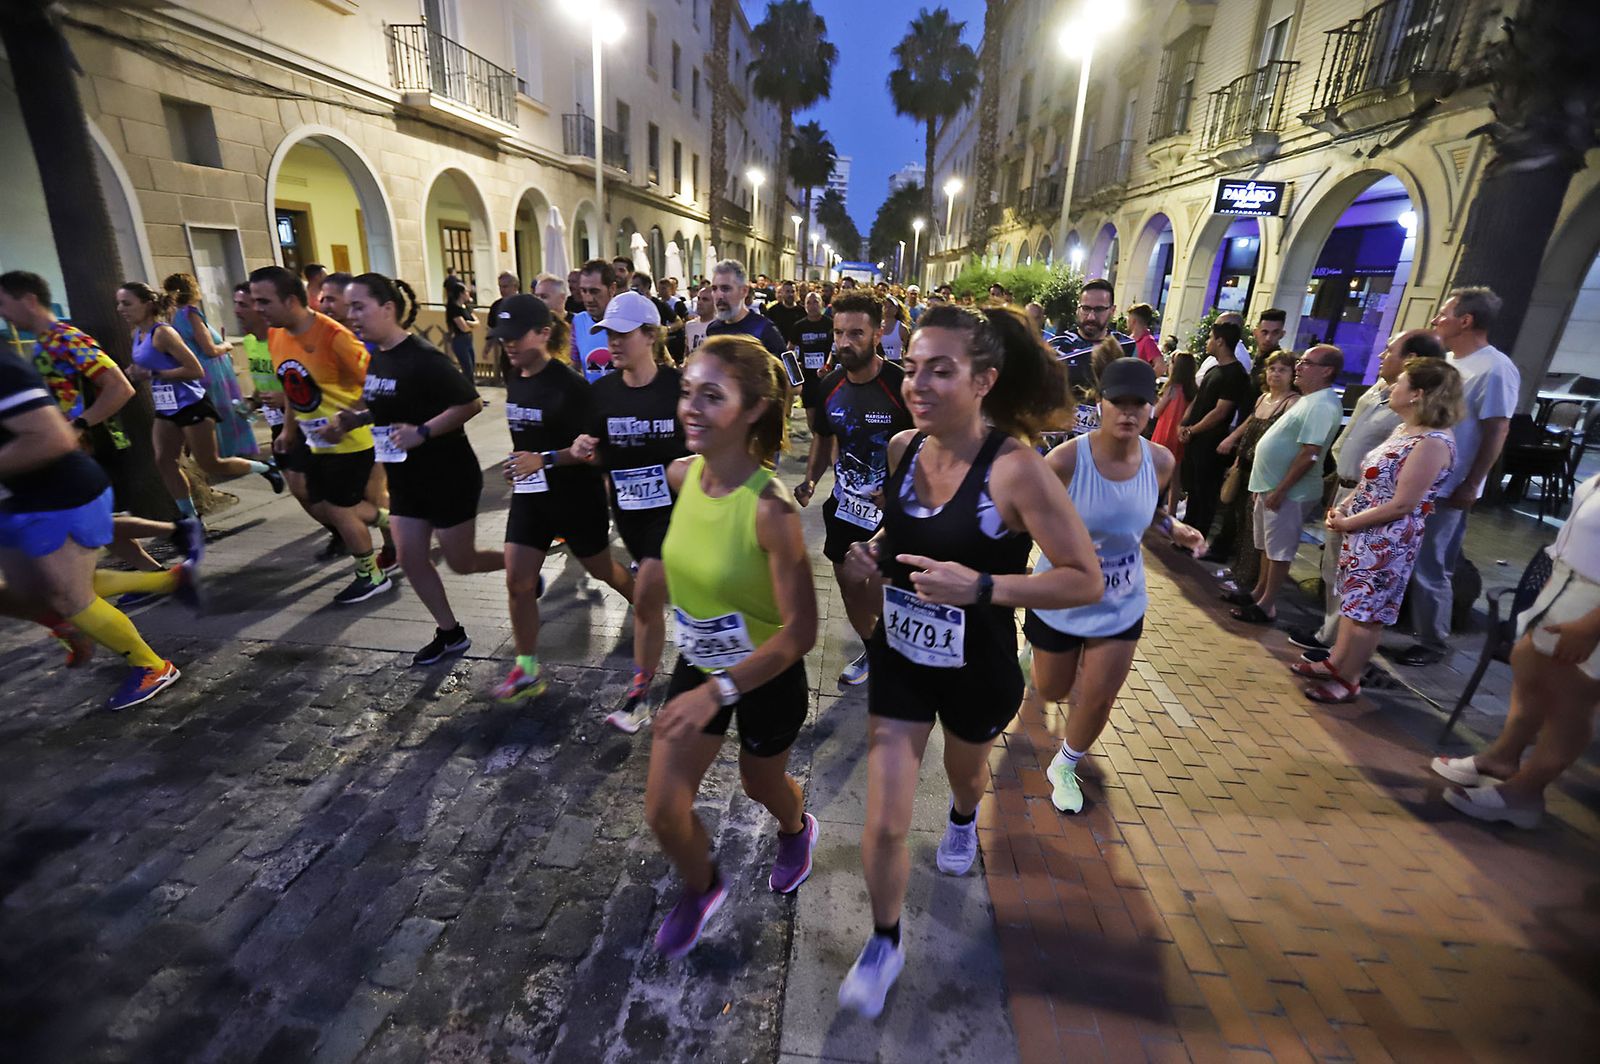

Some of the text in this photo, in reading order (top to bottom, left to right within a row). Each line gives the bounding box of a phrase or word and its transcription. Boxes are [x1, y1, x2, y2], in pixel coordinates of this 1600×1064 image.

[631, 420, 651, 434] FOR
[653, 419, 674, 433] FUN
[851, 501, 870, 518] 197
[900, 616, 936, 648] 479
